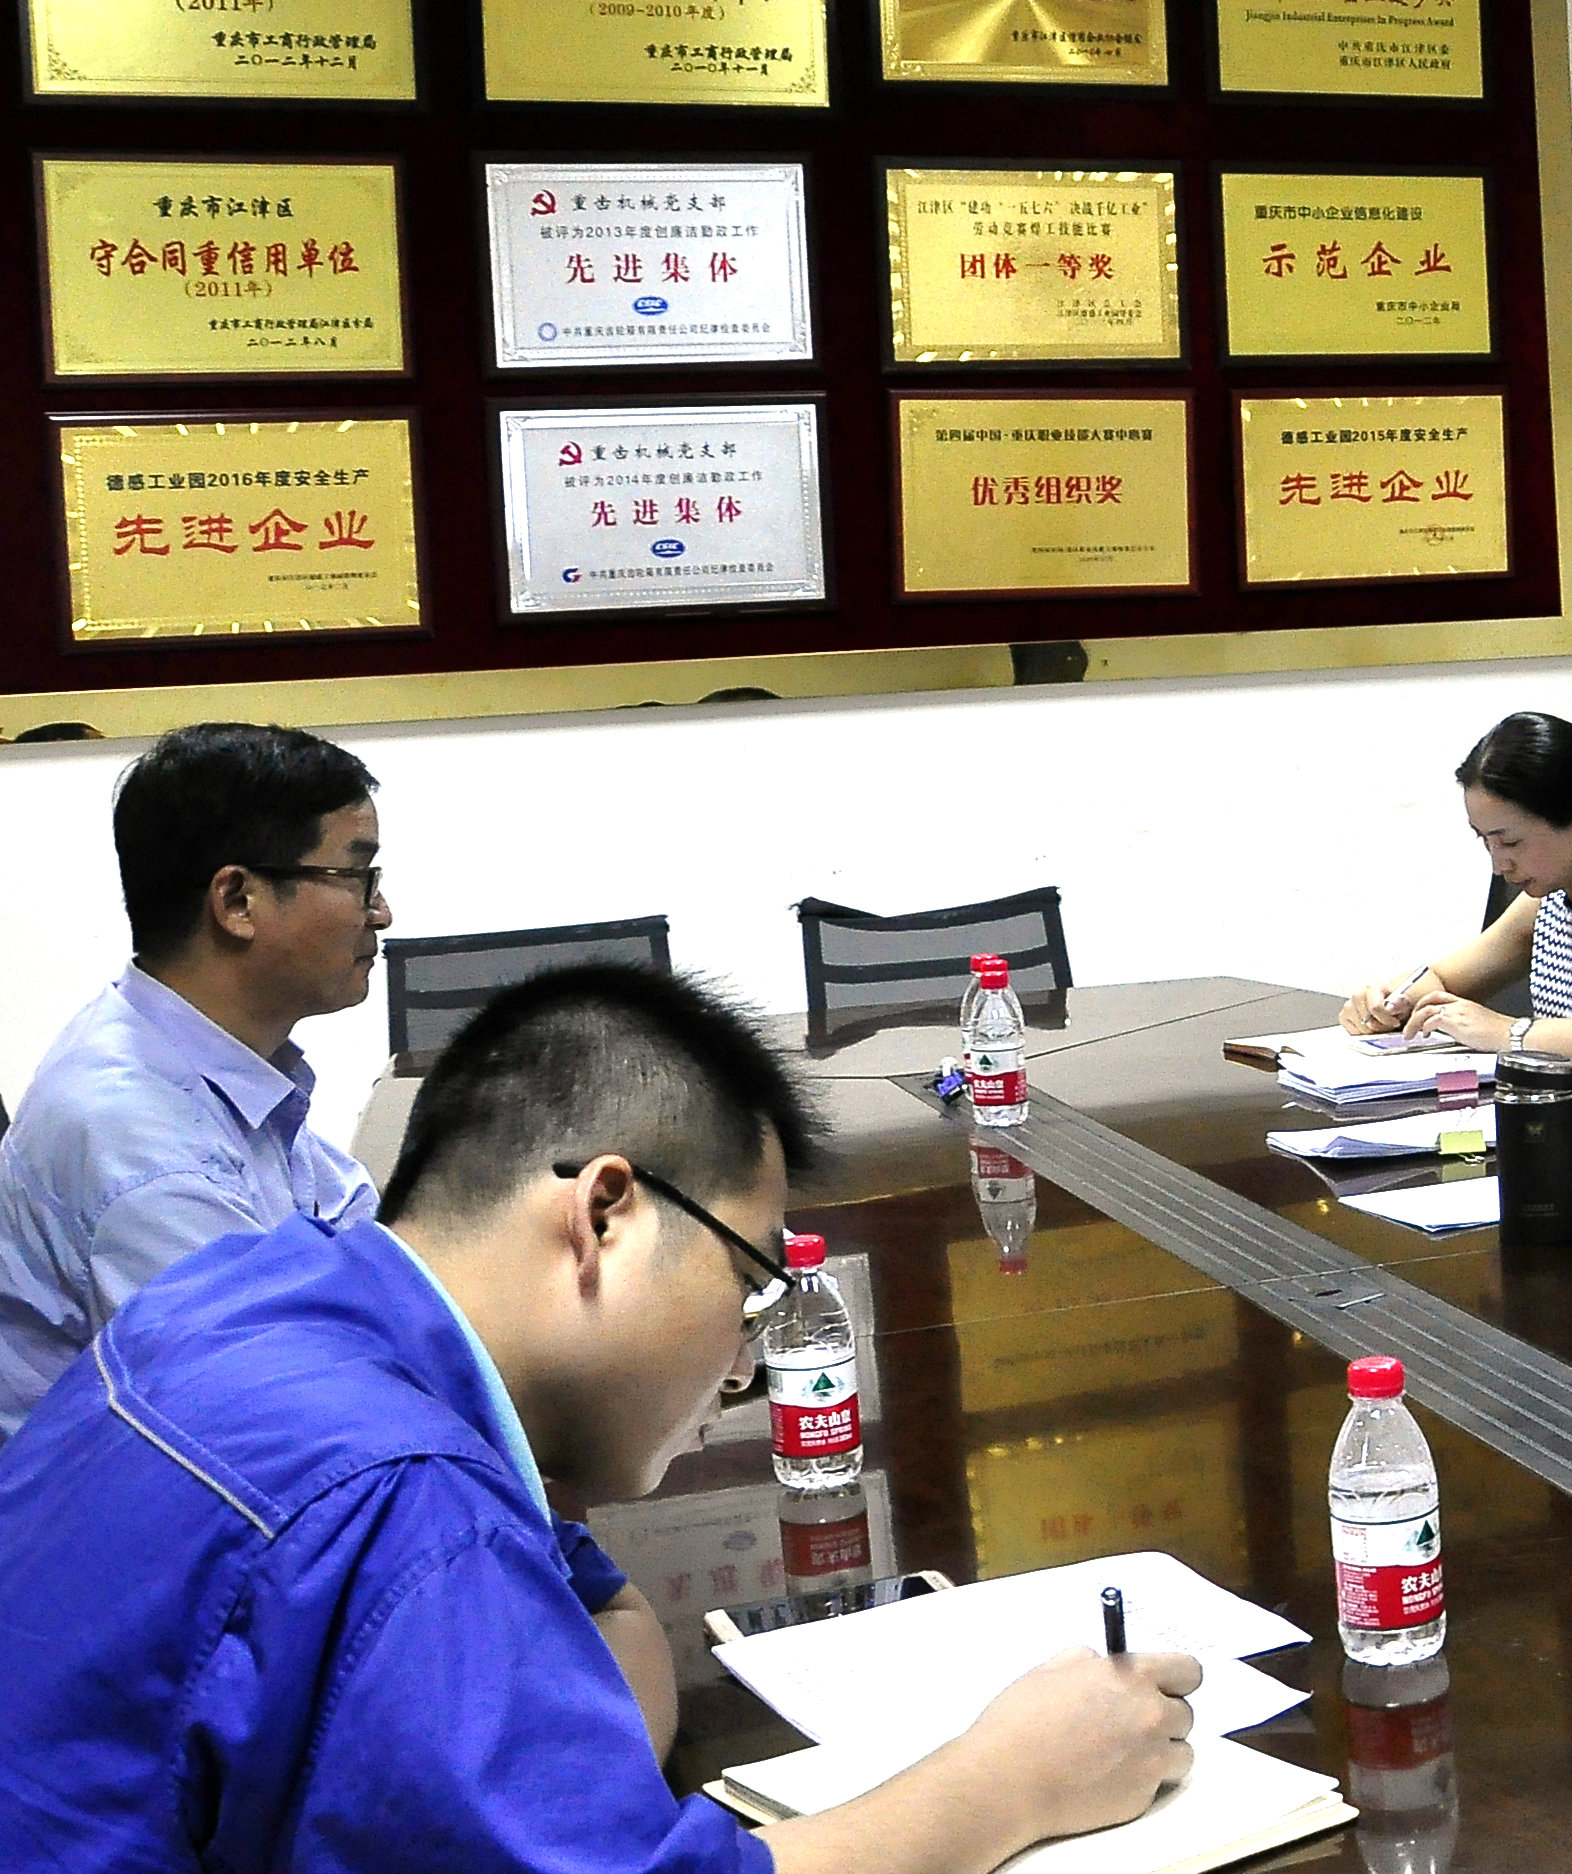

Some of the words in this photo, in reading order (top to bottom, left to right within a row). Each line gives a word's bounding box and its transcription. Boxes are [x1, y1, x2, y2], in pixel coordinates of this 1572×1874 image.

[1426, 17, 1455, 27] Award
[211, 31, 377, 50] 重庆市工商行政管理局
[1337, 40, 1450, 55] 中共重庆市江津区委
[644, 43, 793, 61] 重庆市工商行政管理局
[1339, 56, 1452, 70] 重庆市江津区人民政府
[153, 195, 295, 220] 重庆市江津区
[570, 192, 727, 213] 重齿机械党支部
[1254, 204, 1423, 221] 重庆市中小企业信息化建设
[540, 225, 760, 240] 被评为2013年度创廉洁勤政工作
[90, 238, 360, 278] 守合同重信用单位
[566, 252, 738, 284] 先进集体
[960, 252, 1114, 280] 团体一等奖
[1262, 240, 1453, 280] 示范企业
[1281, 427, 1468, 445] 德感工业园2015年度安全生产
[590, 440, 738, 462] 重齿机械党支部
[106, 467, 371, 492] 德感工业园2016年度安全生产
[564, 468, 764, 488] 被评为2014年度创廉洁勤政工作
[1279, 469, 1474, 506] 先进企业
[971, 474, 1124, 507] 优秀组织奖
[591, 495, 742, 528] 先进集体
[113, 507, 375, 556] 先进企业
[798, 1409, 851, 1431] 农夫山泉
[1401, 1565, 1442, 1595] 农夫山
